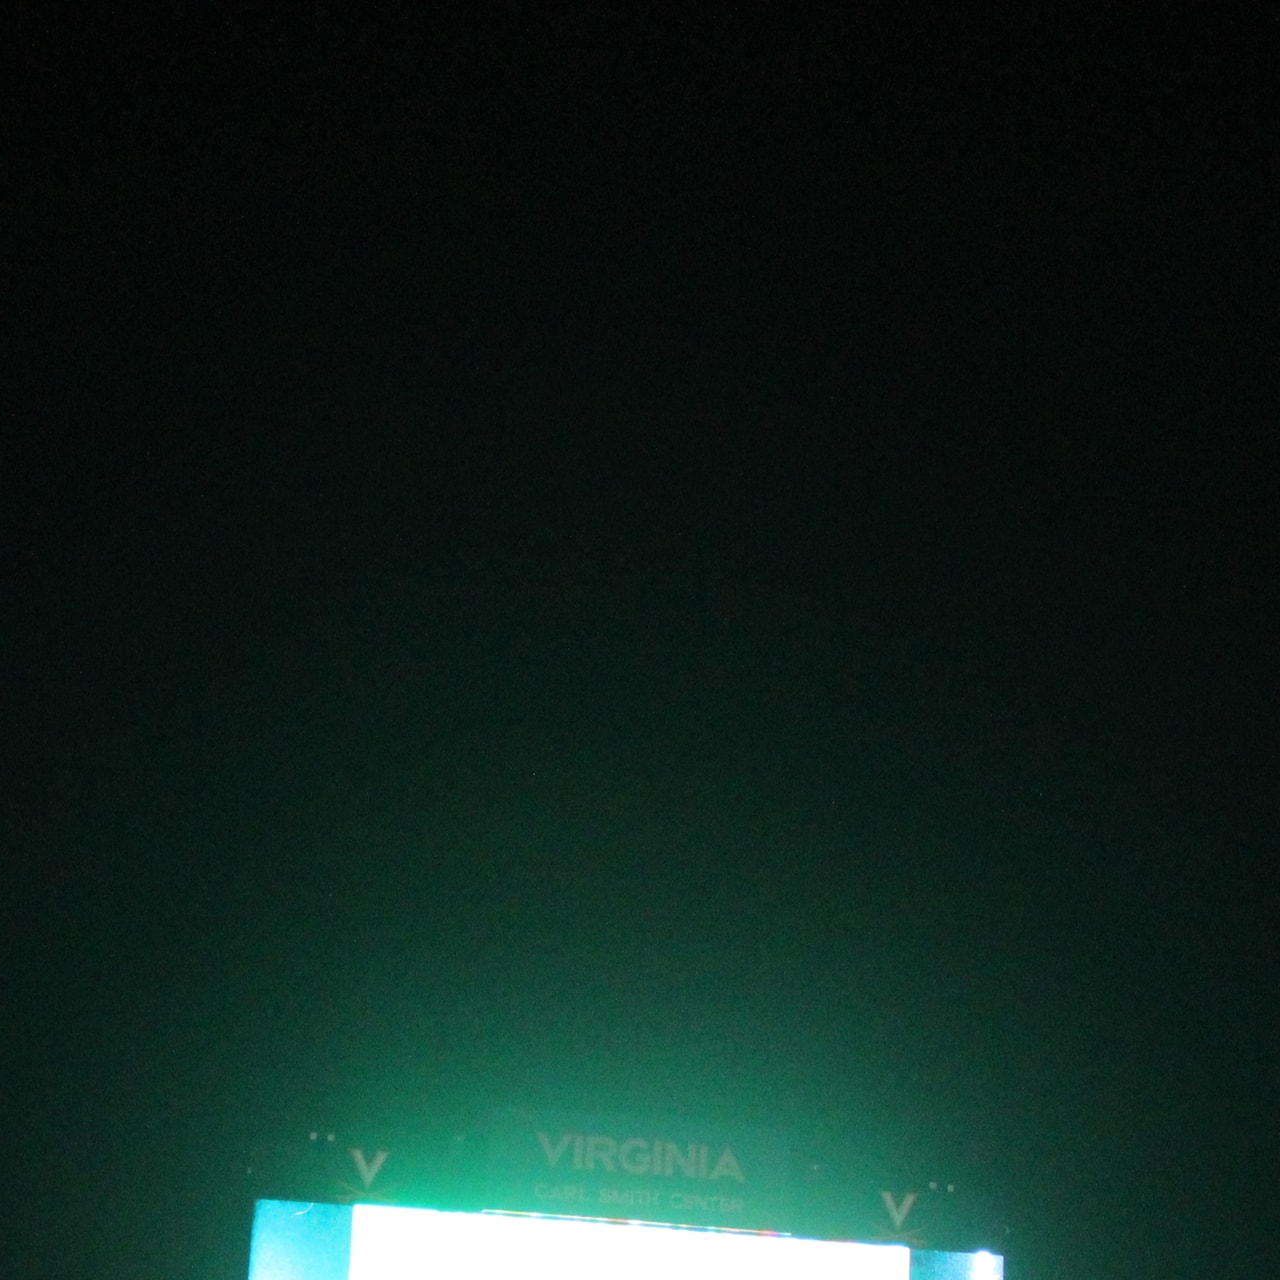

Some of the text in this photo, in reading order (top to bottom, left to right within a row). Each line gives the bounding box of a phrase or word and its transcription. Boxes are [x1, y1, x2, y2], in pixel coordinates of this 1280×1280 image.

[536, 1132, 745, 1183] VIRGINIA
[534, 1183, 744, 1213] CARL SMITH CENTER
